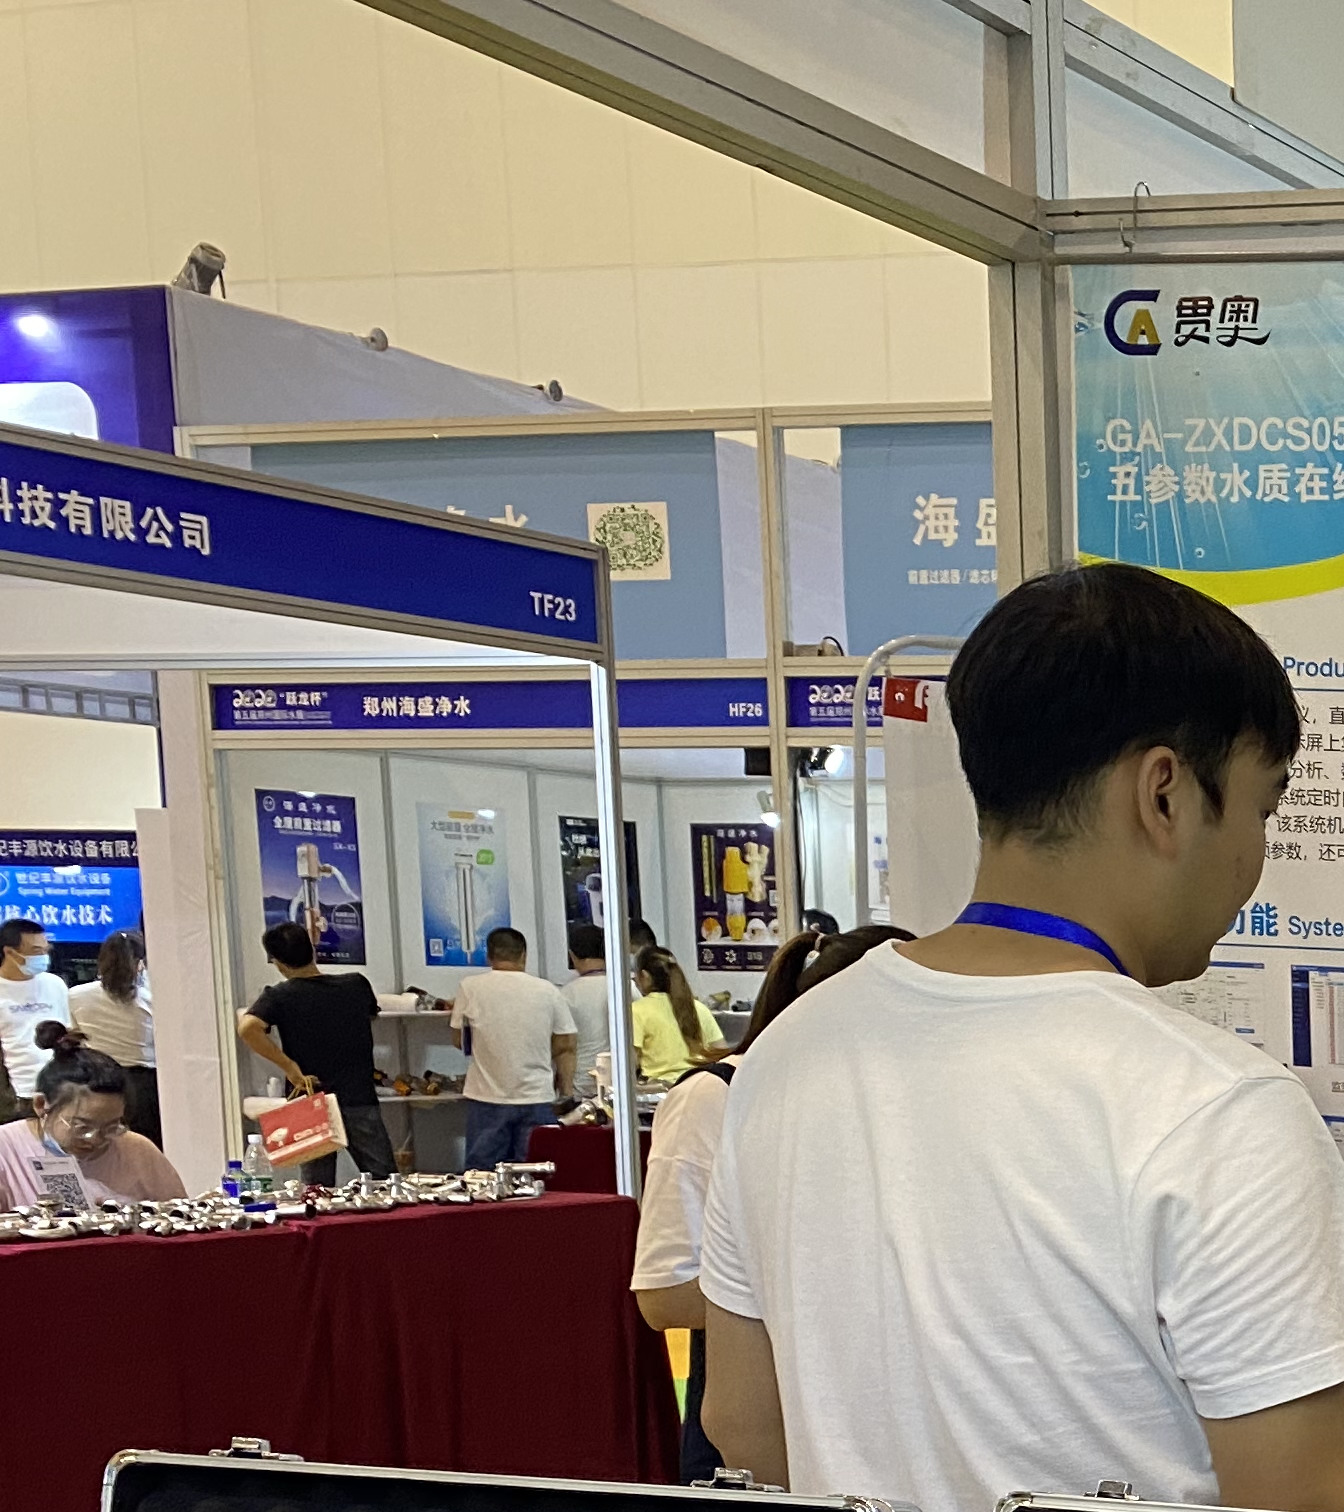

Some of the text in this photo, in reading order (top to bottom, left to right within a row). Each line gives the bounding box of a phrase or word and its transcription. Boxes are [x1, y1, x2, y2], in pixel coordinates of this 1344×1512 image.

[1172, 295, 1272, 349] 贯奥
[529, 591, 577, 623] TF23
[362, 696, 472, 717] 郑州海盛净水
[729, 702, 763, 718] HF26
